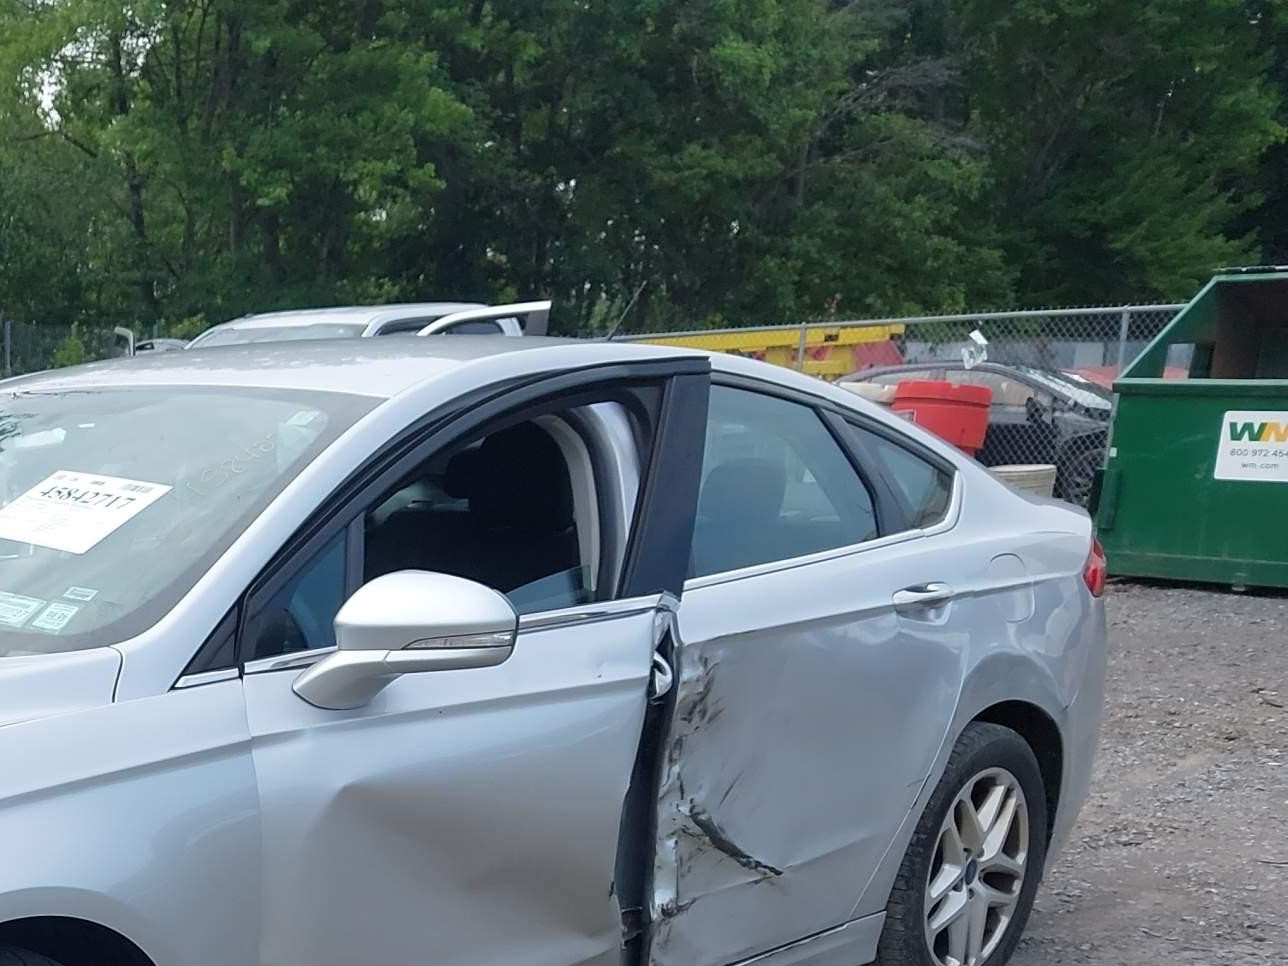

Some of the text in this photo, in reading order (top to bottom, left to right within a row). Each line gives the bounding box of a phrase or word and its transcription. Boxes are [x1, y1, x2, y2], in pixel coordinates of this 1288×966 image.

[1229, 421, 1288, 442] WM
[1229, 448, 1249, 457] 800
[1251, 448, 1270, 457] 972
[1241, 462, 1279, 470] wmcom
[39, 486, 137, 510] 45842717
